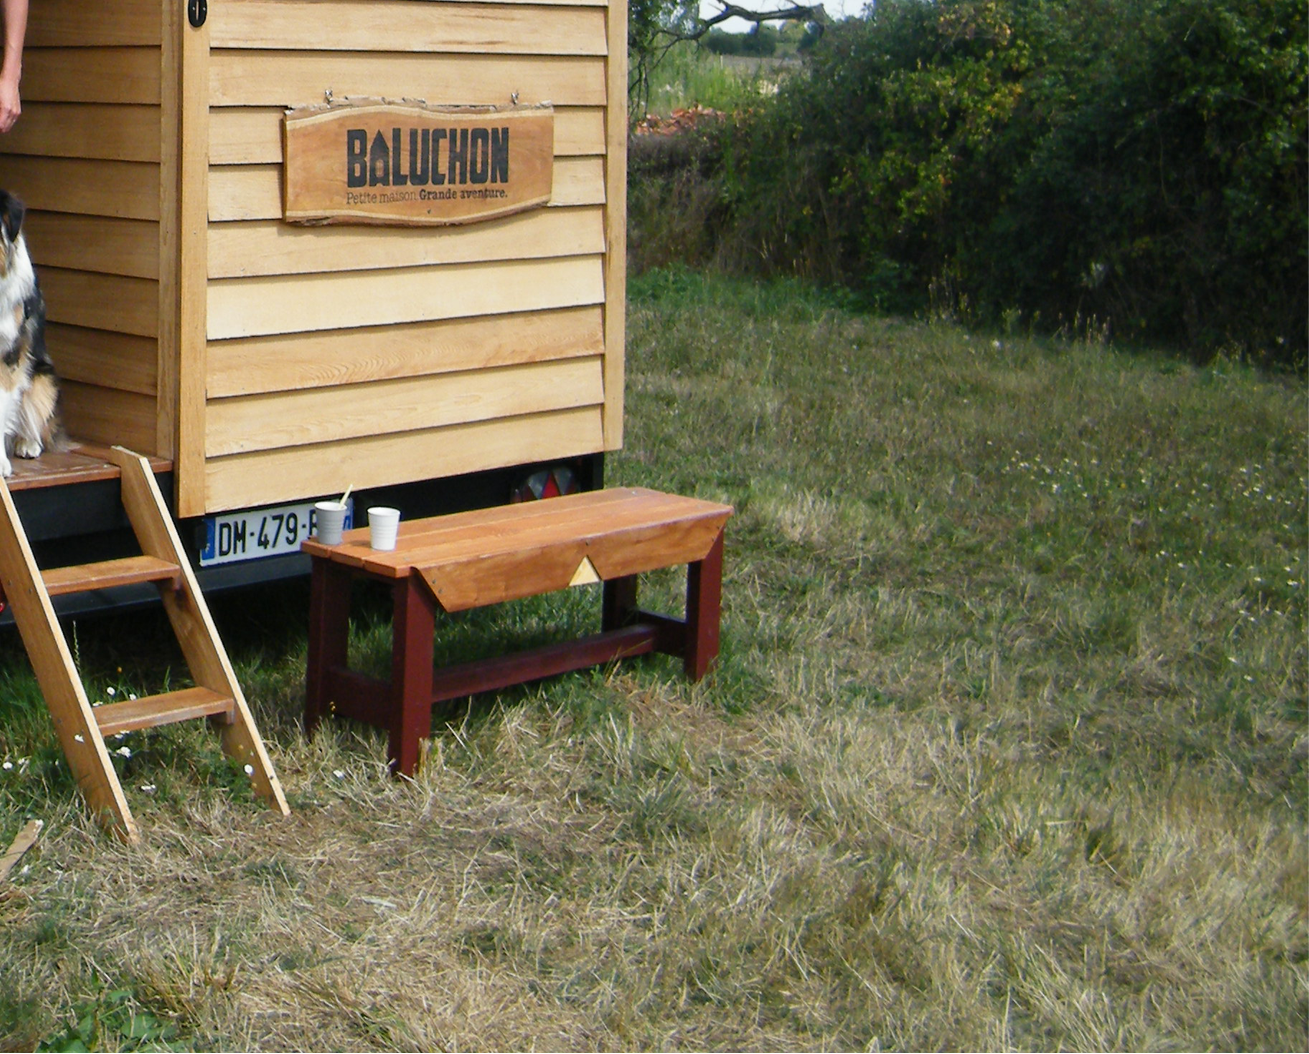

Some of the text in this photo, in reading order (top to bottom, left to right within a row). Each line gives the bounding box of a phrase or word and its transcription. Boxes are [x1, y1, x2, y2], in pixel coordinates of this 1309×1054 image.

[347, 127, 509, 187] BALUCHON
[346, 192, 377, 205] Petite
[419, 189, 458, 200] Grande
[460, 187, 508, 199] aventure.
